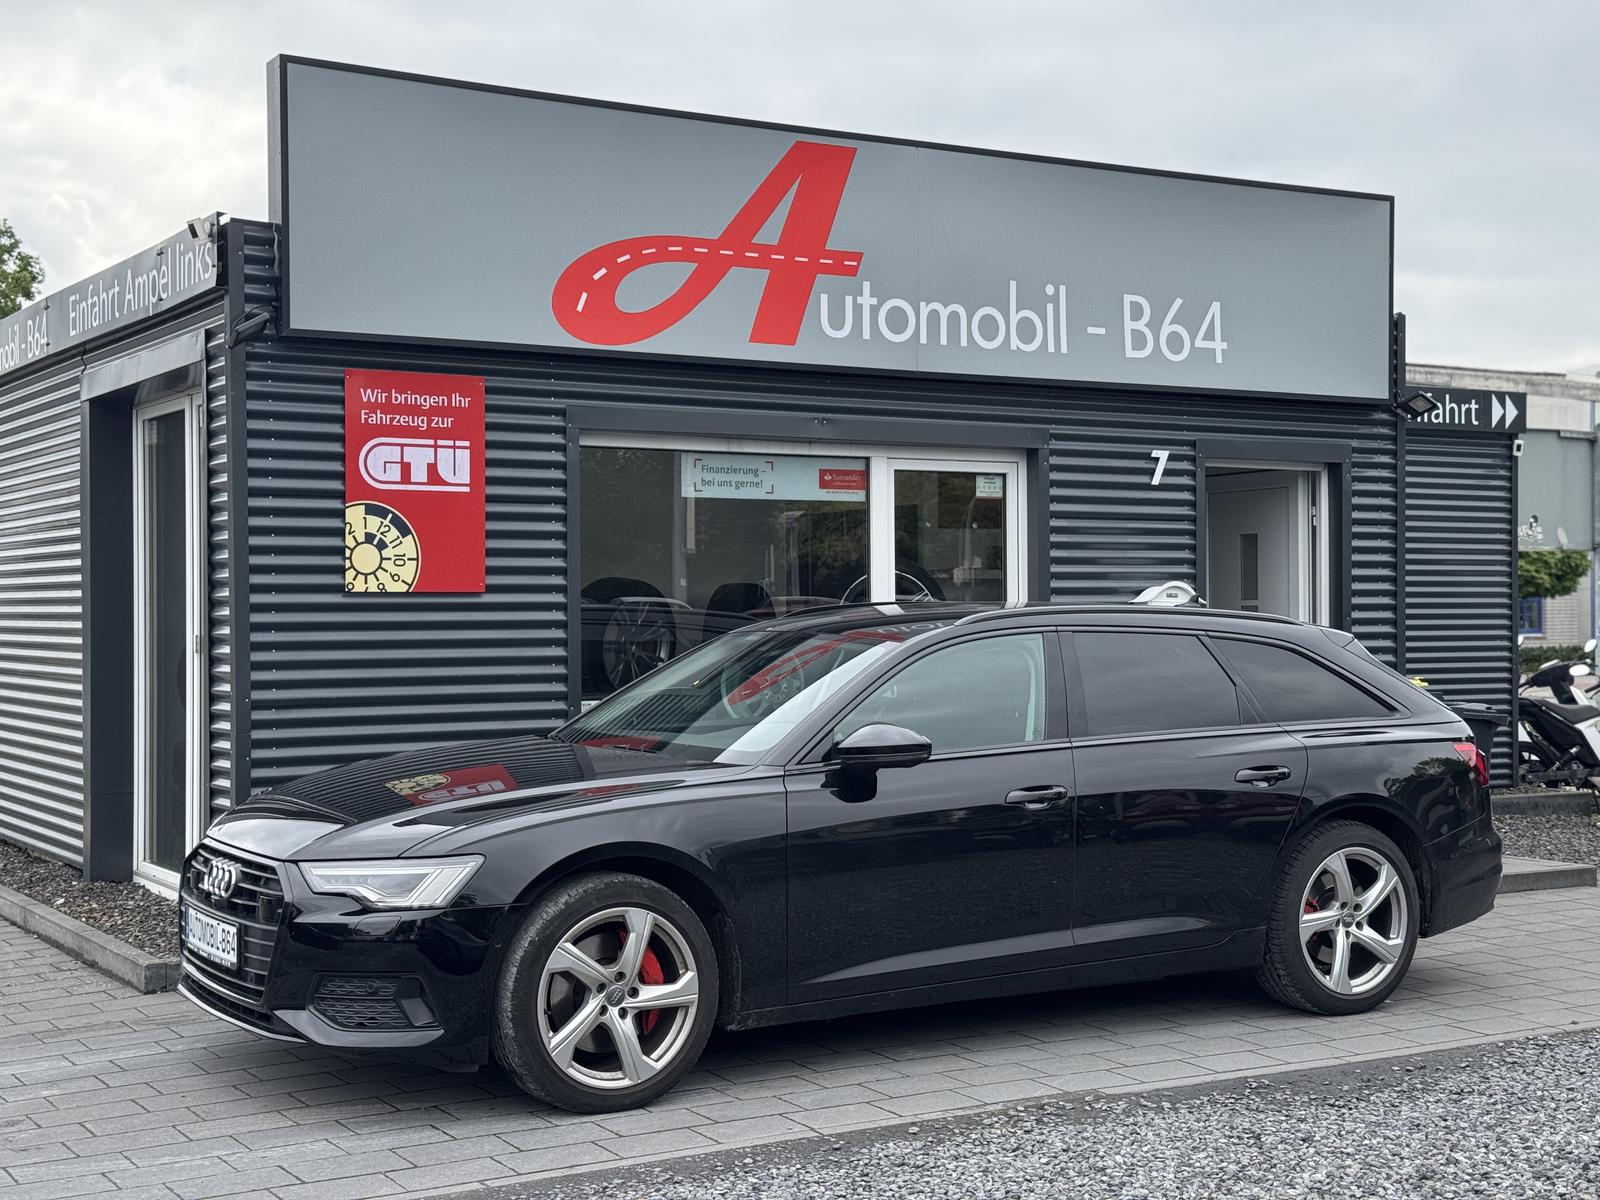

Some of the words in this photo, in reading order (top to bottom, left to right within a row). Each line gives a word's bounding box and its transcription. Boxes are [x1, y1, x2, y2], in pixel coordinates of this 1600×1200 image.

[69, 279, 120, 337] Einfahrt
[124, 248, 172, 316] Ampel
[176, 242, 212, 292] links
[27, 313, 48, 359] B64
[1087, 326, 1106, 335] -
[1123, 294, 1228, 364] B64
[360, 388, 388, 403] Wir
[392, 389, 448, 409] bringen
[452, 392, 471, 408] Ihr
[360, 409, 427, 430] Fahrzeug
[431, 416, 454, 428] zur
[360, 437, 471, 491] GTÜ
[701, 464, 759, 477] Finanzierung
[1151, 450, 1170, 486] 7
[701, 477, 715, 487] bei
[717, 479, 733, 488] uns
[734, 480, 763, 490] gerne!
[345, 521, 356, 535] 2
[362, 517, 368, 530] 1
[376, 520, 392, 538] 12
[388, 535, 403, 549] 11
[393, 553, 406, 567] 10
